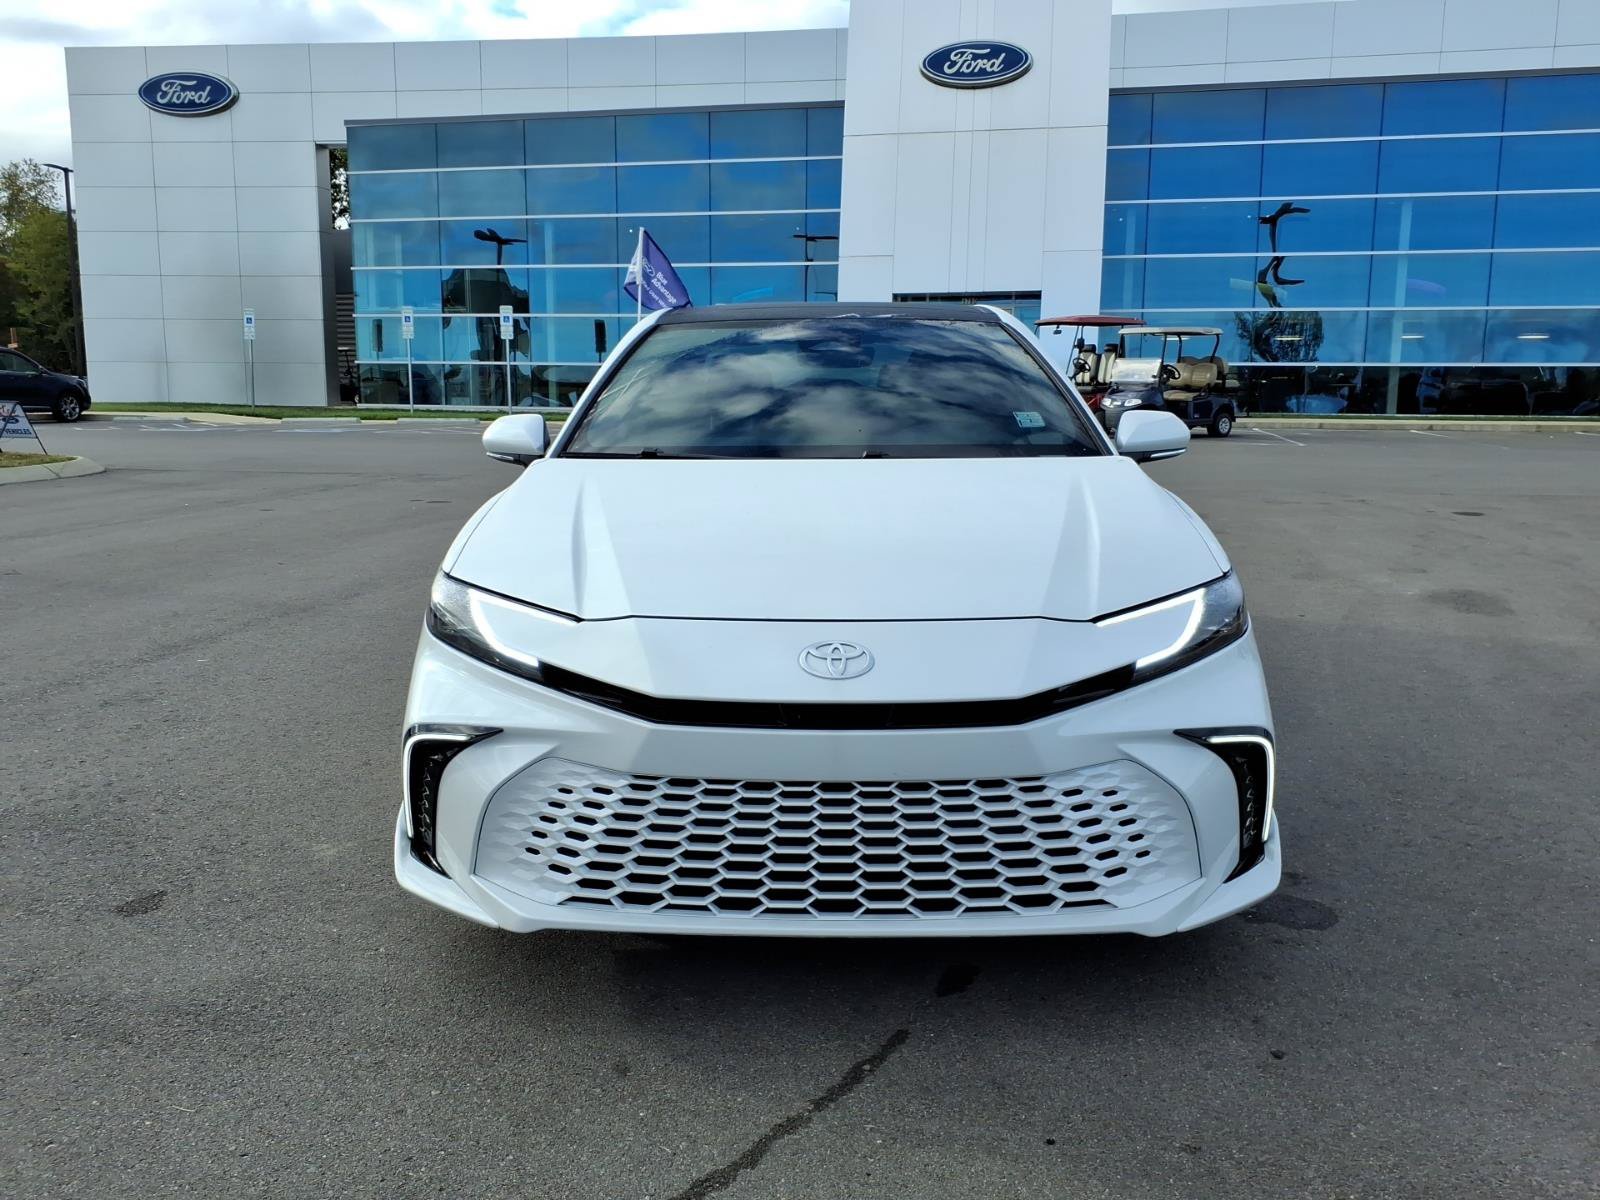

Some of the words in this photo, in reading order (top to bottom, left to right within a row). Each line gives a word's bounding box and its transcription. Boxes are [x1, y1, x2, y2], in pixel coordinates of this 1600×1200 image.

[944, 48, 1006, 75] Ford
[156, 79, 212, 104] Ford
[651, 278, 678, 305] Advantage
[656, 271, 668, 286] Blue
